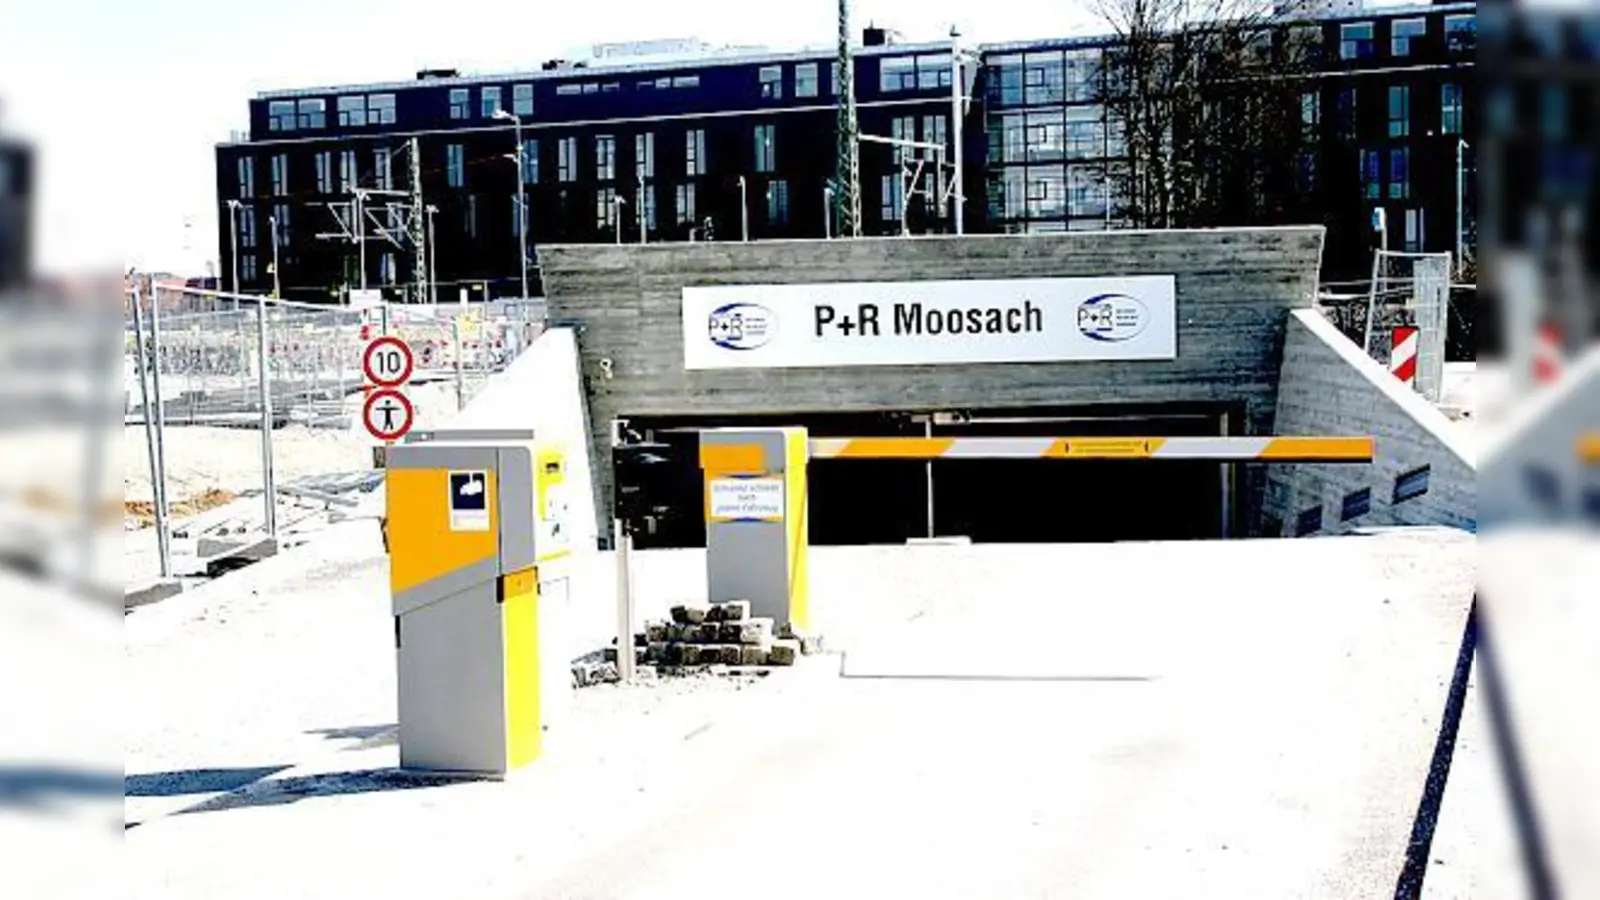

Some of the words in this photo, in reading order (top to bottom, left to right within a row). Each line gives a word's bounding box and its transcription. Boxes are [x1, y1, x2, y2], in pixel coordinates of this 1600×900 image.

[708, 314, 743, 337] P+R
[814, 303, 880, 337] P+R
[894, 300, 1043, 336] Moosach
[1077, 306, 1112, 327] P+R
[375, 351, 401, 374] 10
